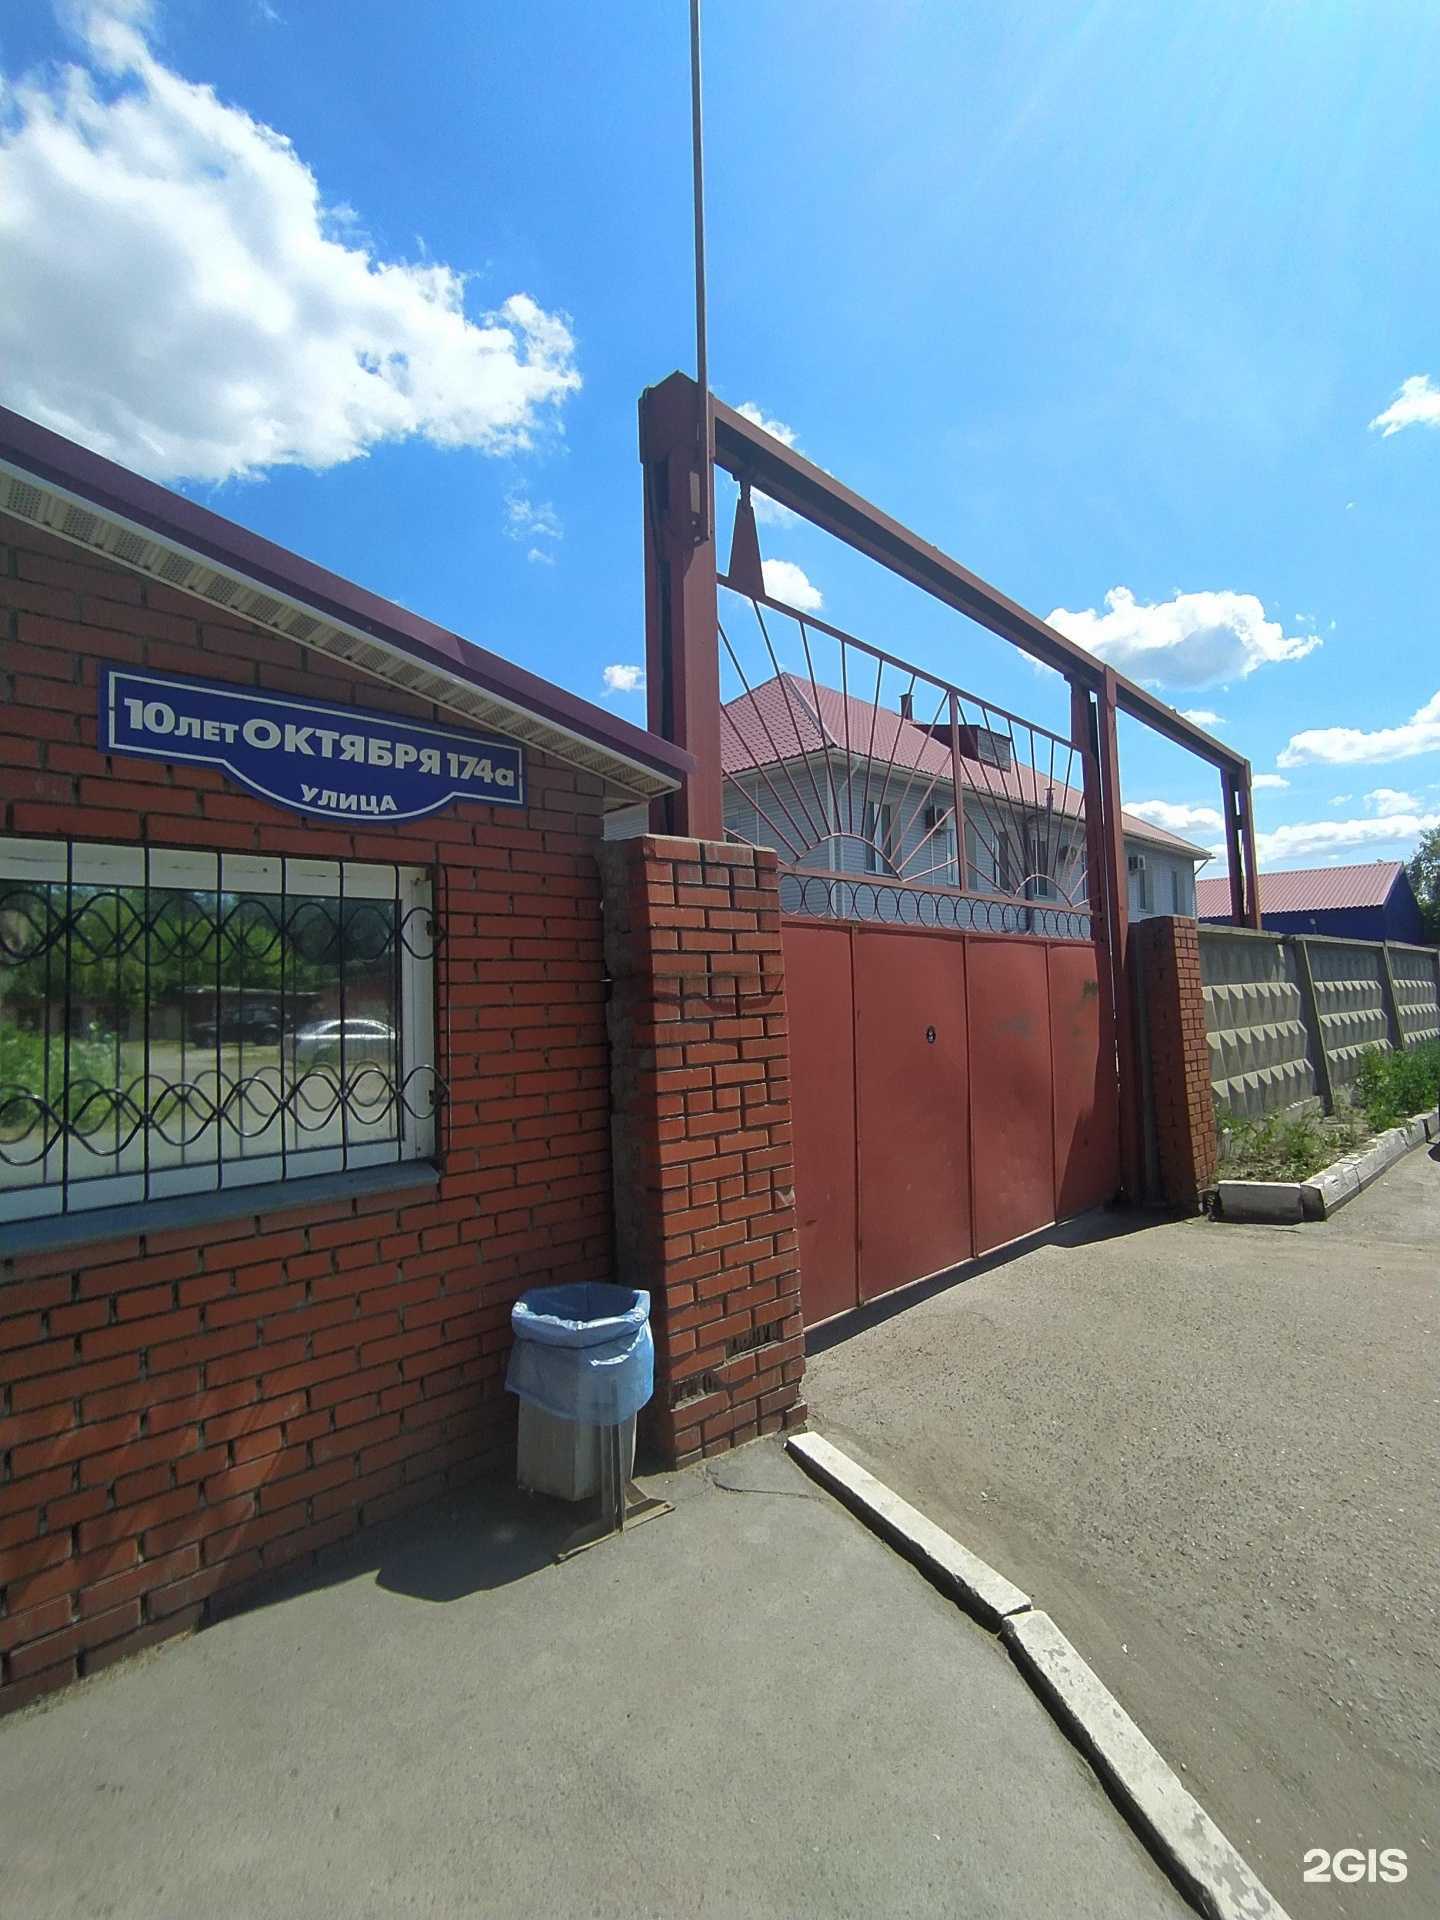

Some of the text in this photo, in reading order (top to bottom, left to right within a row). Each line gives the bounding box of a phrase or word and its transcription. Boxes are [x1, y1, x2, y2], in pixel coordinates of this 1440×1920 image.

[124, 697, 176, 734] 10
[242, 718, 441, 776] ОКТЯБРЯ
[445, 752, 515, 787] 174а
[300, 783, 398, 815] УЛИЦА
